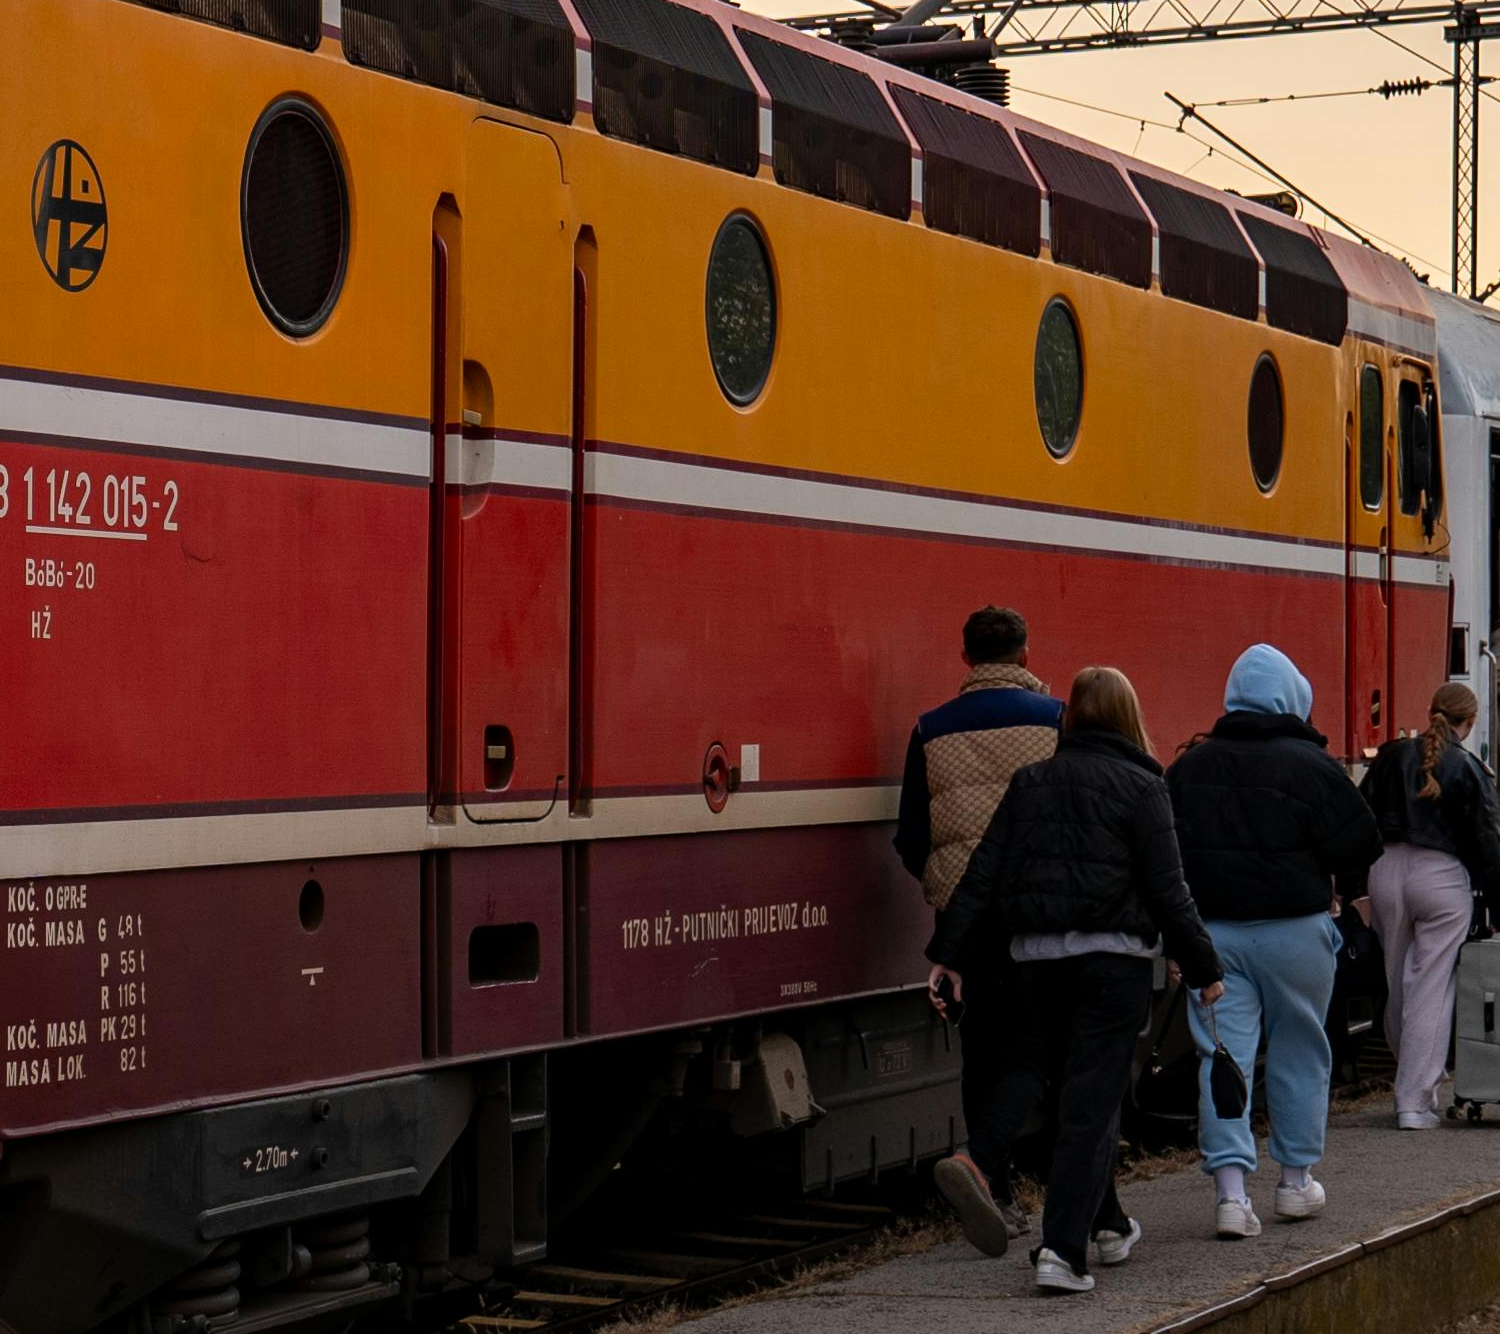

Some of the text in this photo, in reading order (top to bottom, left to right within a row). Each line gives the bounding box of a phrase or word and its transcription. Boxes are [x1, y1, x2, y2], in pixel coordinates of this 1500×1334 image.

[103, 475, 179, 532] 015-2
[31, 604, 51, 639] HŽ
[8, 881, 39, 913] KOČ.
[7, 913, 142, 949] KOČ. MASA G 48 t
[622, 918, 649, 950] 1178
[744, 902, 798, 937] PRIJEVOZ
[802, 901, 828, 928] d.o.o.
[100, 949, 145, 977] P 55 t
[101, 981, 146, 1011] R 116 t
[7, 1013, 146, 1051] KOČ. MASA PK 29 t
[6, 1045, 146, 1087] MASA LOK. 82 t
[256, 1146, 288, 1173] 2.70m
